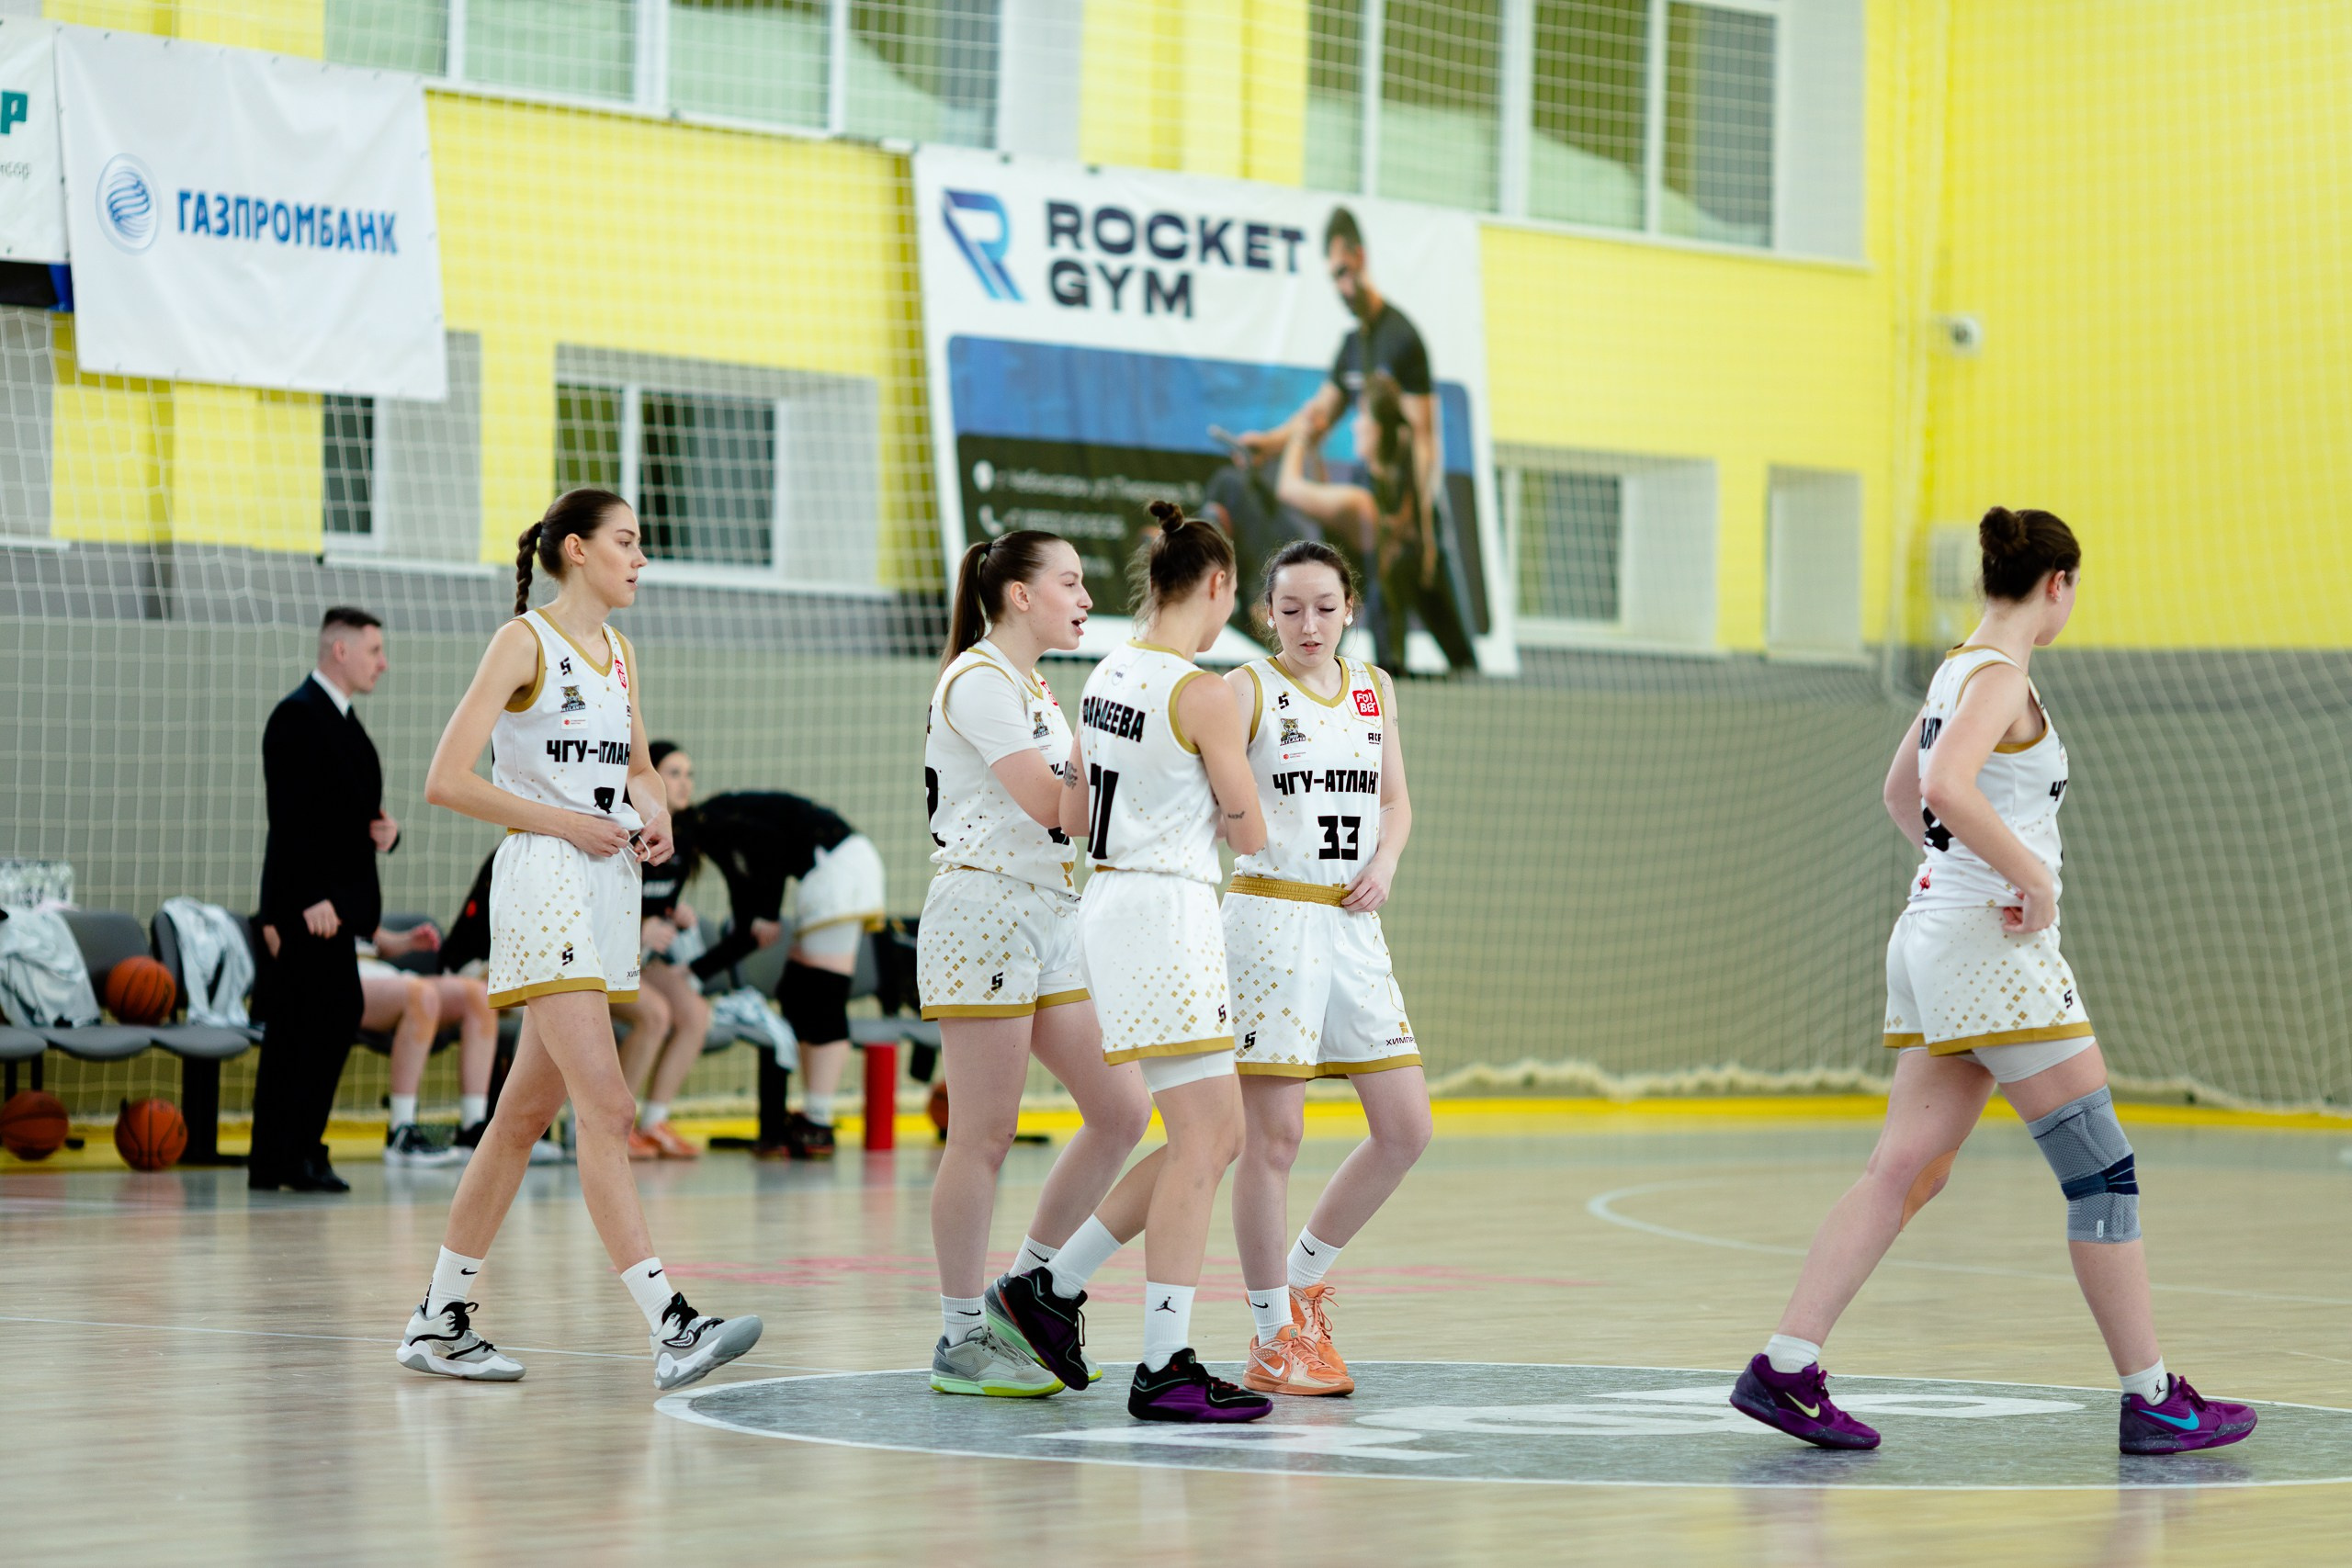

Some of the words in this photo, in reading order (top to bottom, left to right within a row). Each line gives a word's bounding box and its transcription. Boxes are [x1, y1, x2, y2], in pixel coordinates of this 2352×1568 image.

[177, 189, 398, 254] ГАЗПРОМБАНК
[1046, 199, 1304, 273] ROCKET
[1049, 259, 1193, 318] GYM
[1317, 816, 1361, 861] 33
